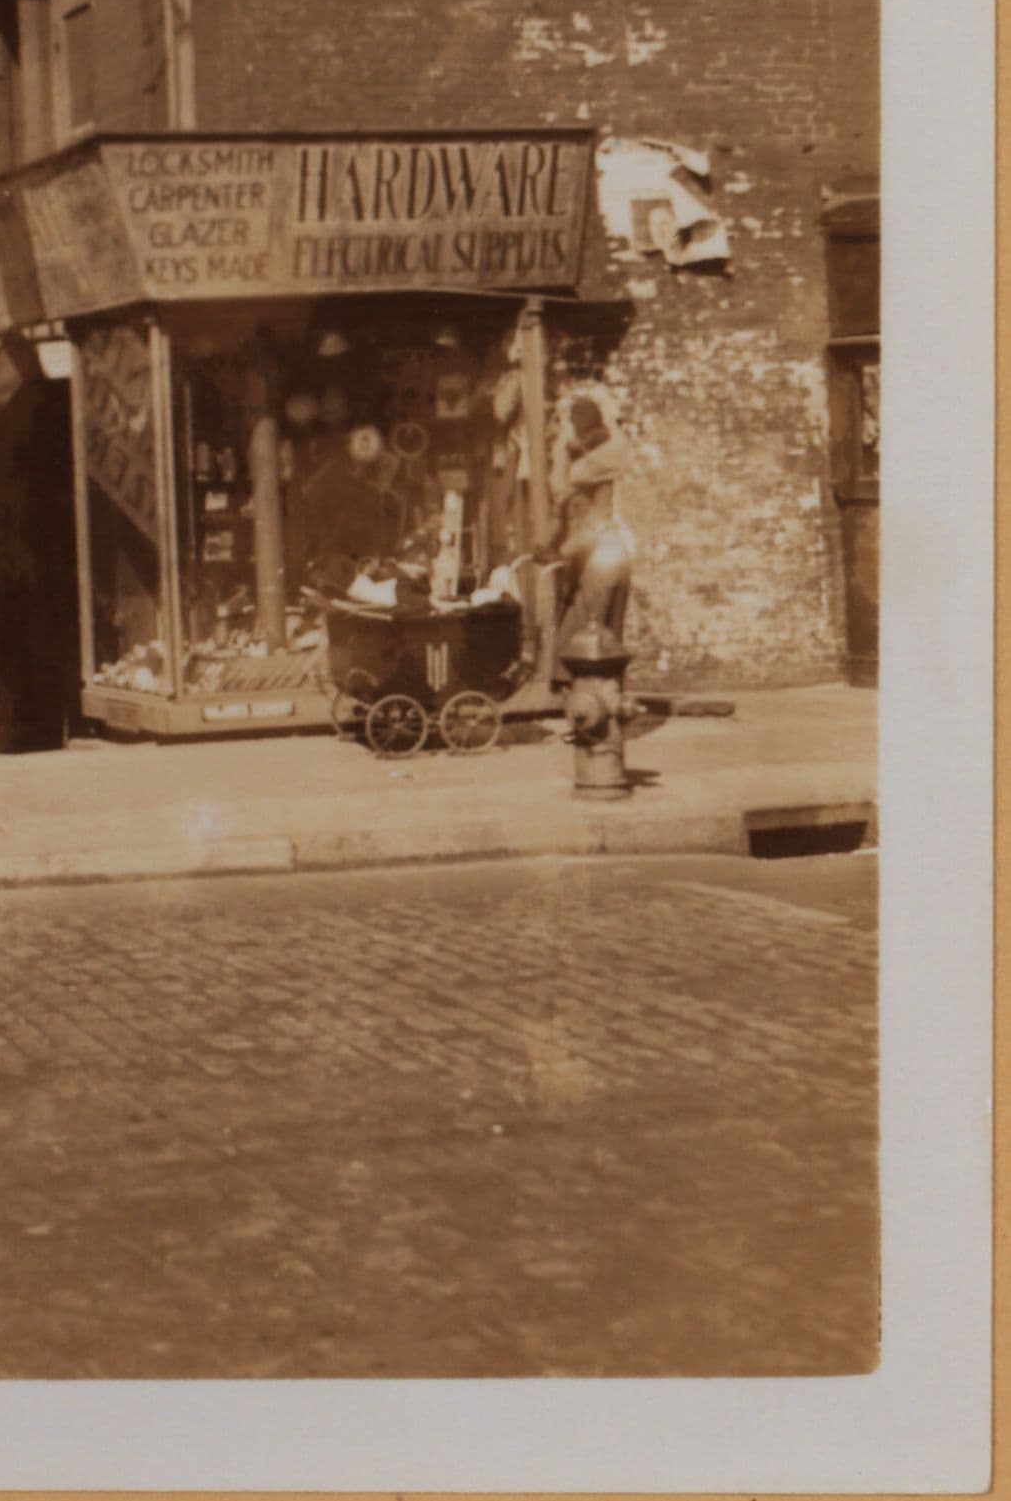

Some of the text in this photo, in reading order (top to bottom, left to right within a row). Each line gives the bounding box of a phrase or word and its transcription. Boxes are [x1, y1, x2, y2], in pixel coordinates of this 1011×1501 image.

[127, 148, 274, 178] LOCKSMITH
[128, 181, 267, 214] CARPENTER
[298, 143, 569, 223] HARDWARE
[149, 218, 251, 249] GLAZER
[145, 253, 271, 285] KEYS MADE
[293, 230, 566, 279] ELECTRICAL SUPPLIES
